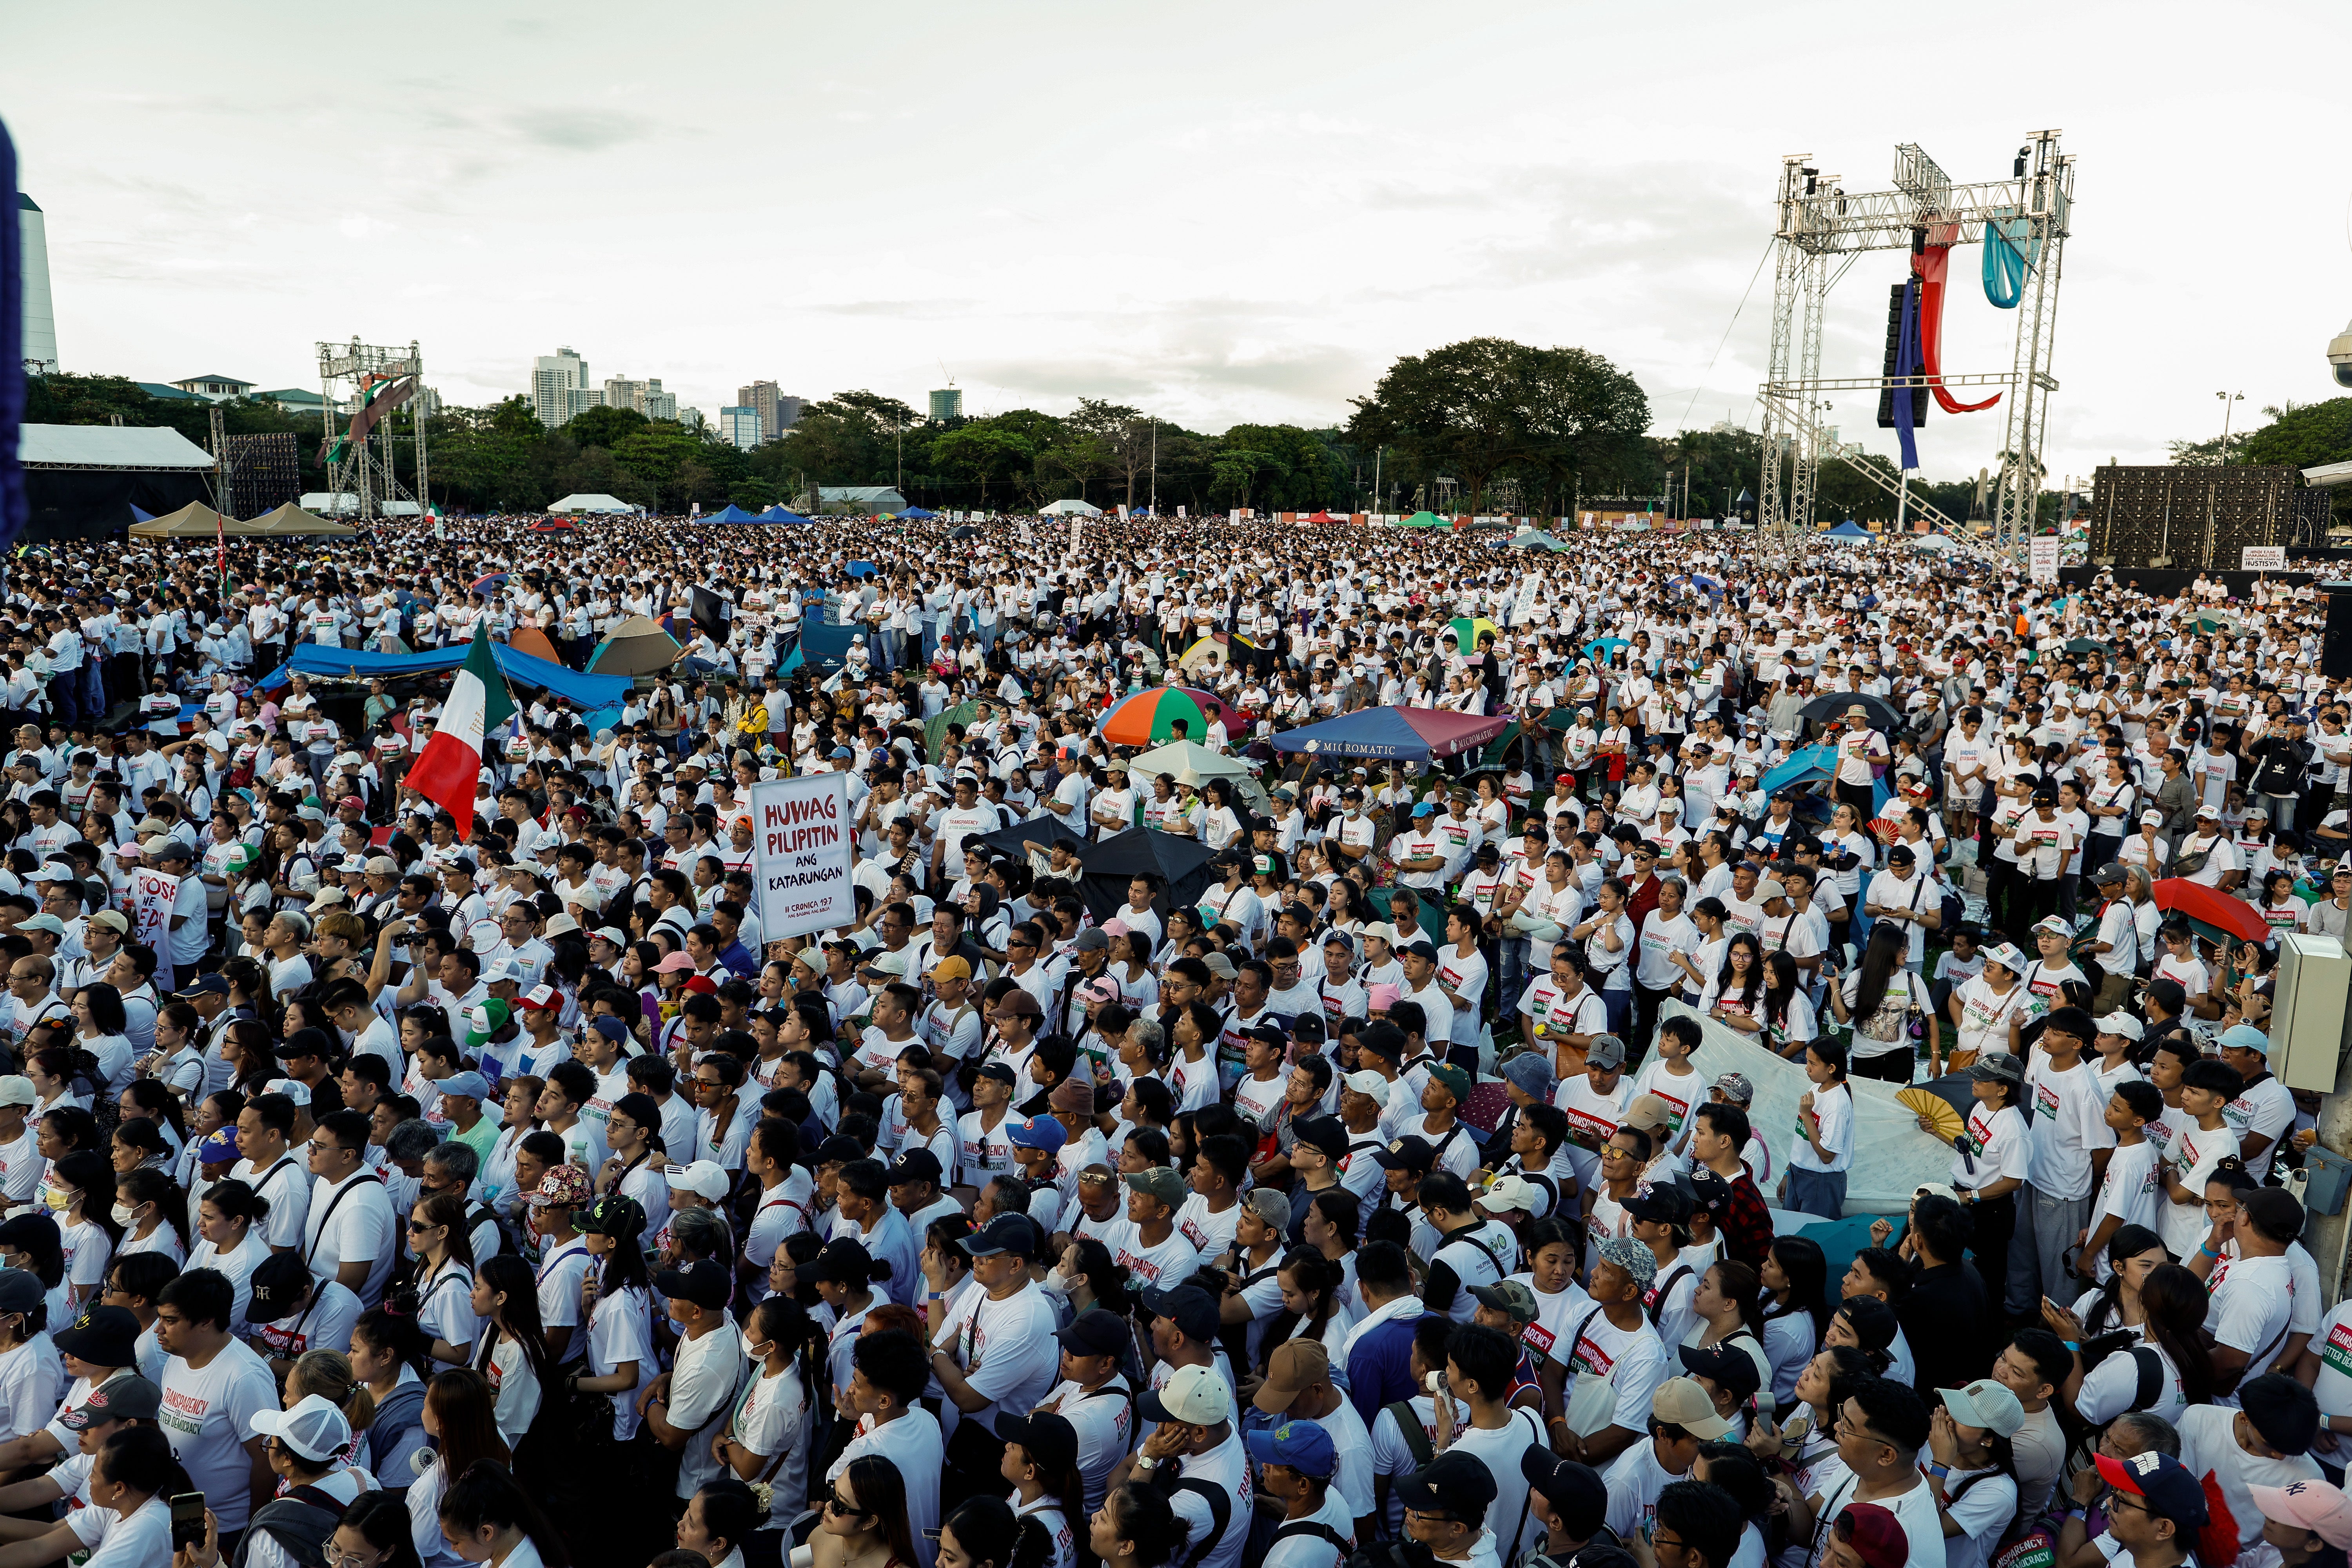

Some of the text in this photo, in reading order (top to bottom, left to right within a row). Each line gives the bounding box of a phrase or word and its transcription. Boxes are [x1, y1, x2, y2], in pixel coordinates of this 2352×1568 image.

[824, 610, 837, 618] ETTER
[1459, 729, 1494, 748] MICROMATIC
[1324, 742, 1395, 755] MICROMATIC
[765, 794, 837, 828] HUWAG
[1269, 819, 1276, 828] LA
[767, 824, 838, 855] PILIPITIN
[796, 853, 817, 867] ANG
[769, 866, 843, 891] KATARUNGAN
[142, 897, 154, 906] HE
[791, 901, 818, 912] CRONICA
[820, 897, 832, 906] 19:7
[1731, 924, 1751, 933] DEMOCRACY
[1645, 931, 1670, 944] RANSPARENCY
[1649, 942, 1668, 951] DEMOCRACY
[1721, 1075, 1741, 1087] GUCCI
[544, 1184, 557, 1195] UP
[545, 1180, 560, 1188] GIVE
[571, 1224, 585, 1234] DALLAS
[1597, 1242, 1606, 1256] USA
[164, 1387, 209, 1416] TRANSPARENCY
[171, 1418, 203, 1436] DEMOCRACY
